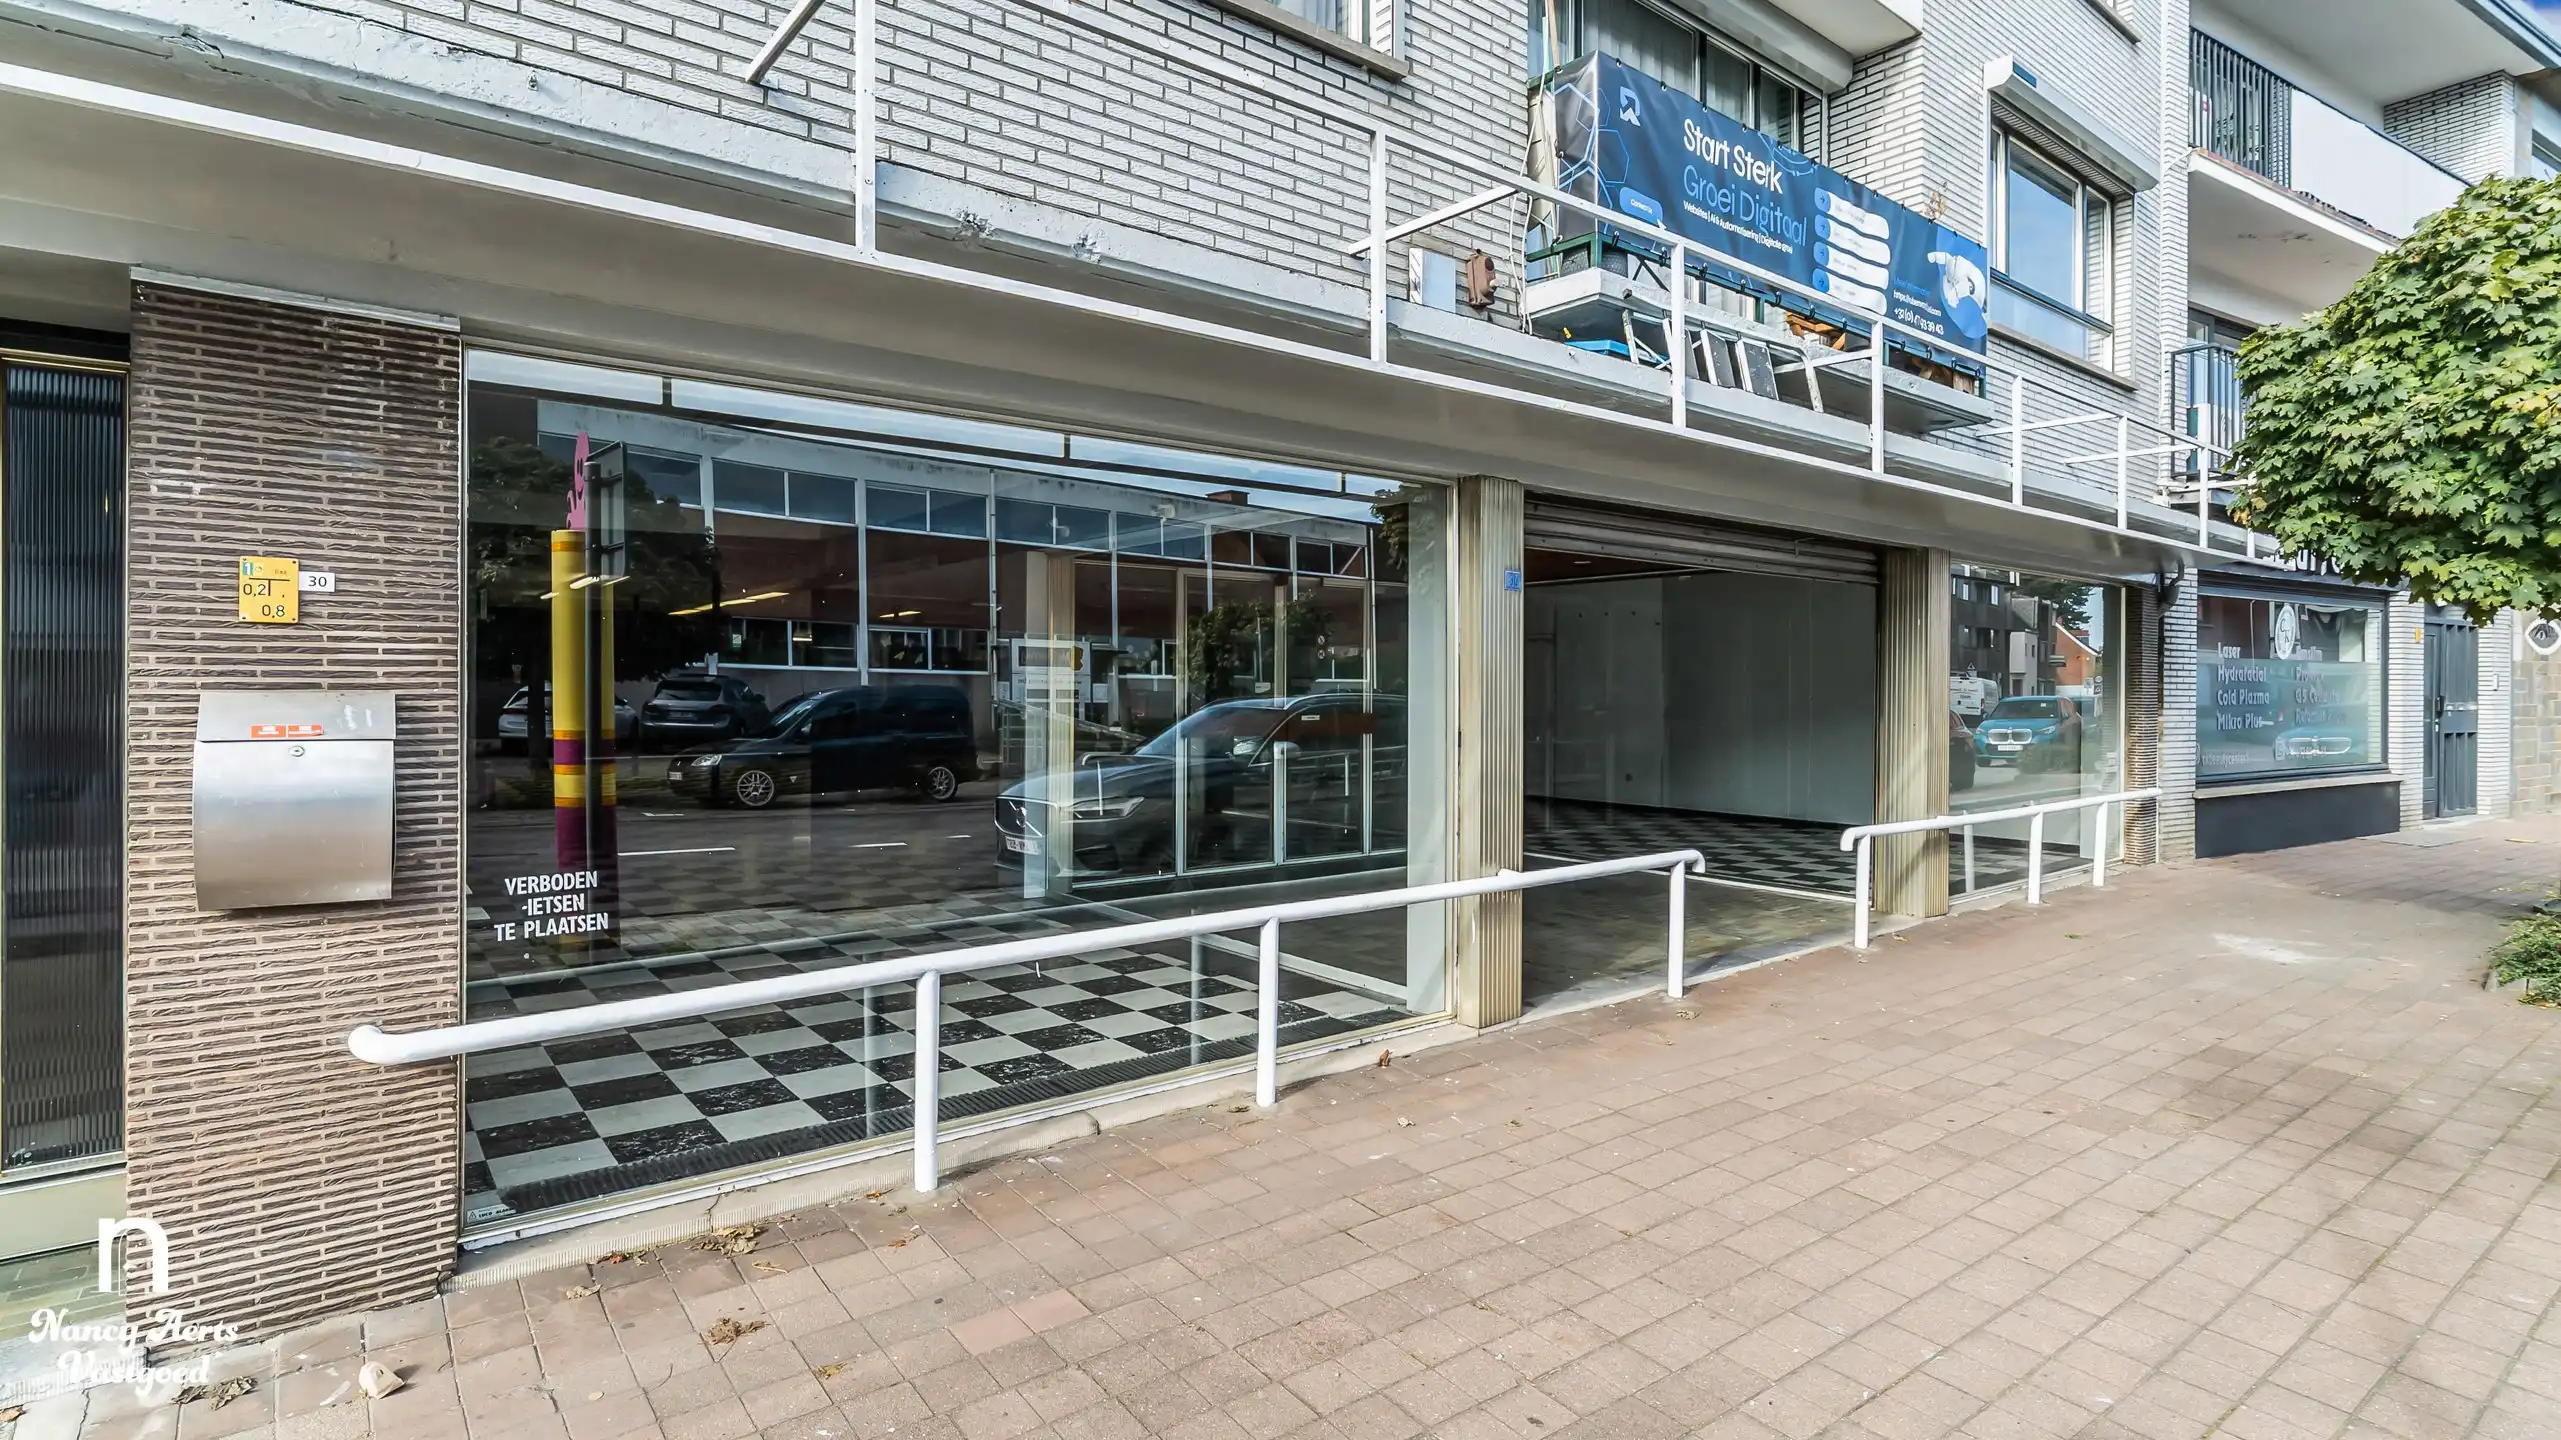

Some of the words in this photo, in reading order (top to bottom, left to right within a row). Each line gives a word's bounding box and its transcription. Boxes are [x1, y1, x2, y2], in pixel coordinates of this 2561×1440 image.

[1683, 118, 1730, 170] Start
[1733, 145, 1783, 194] Sterk
[1683, 165, 1736, 216] Groei
[1740, 188, 1808, 247] Digitaal
[1683, 200, 1708, 220] Websites
[243, 583, 267, 597] 0,2
[308, 575, 328, 588] 30
[262, 604, 286, 619] 0,8
[2217, 641, 2241, 659] Laser
[2217, 664, 2267, 685] Hydrafacial
[2217, 688, 2237, 706] Cold
[2217, 712, 2242, 731] Mikro
[2245, 712, 2263, 729] Plus
[504, 871, 598, 896] VERBODEN
[494, 922, 516, 942] TE
[523, 912, 609, 939] PLAATSEN
